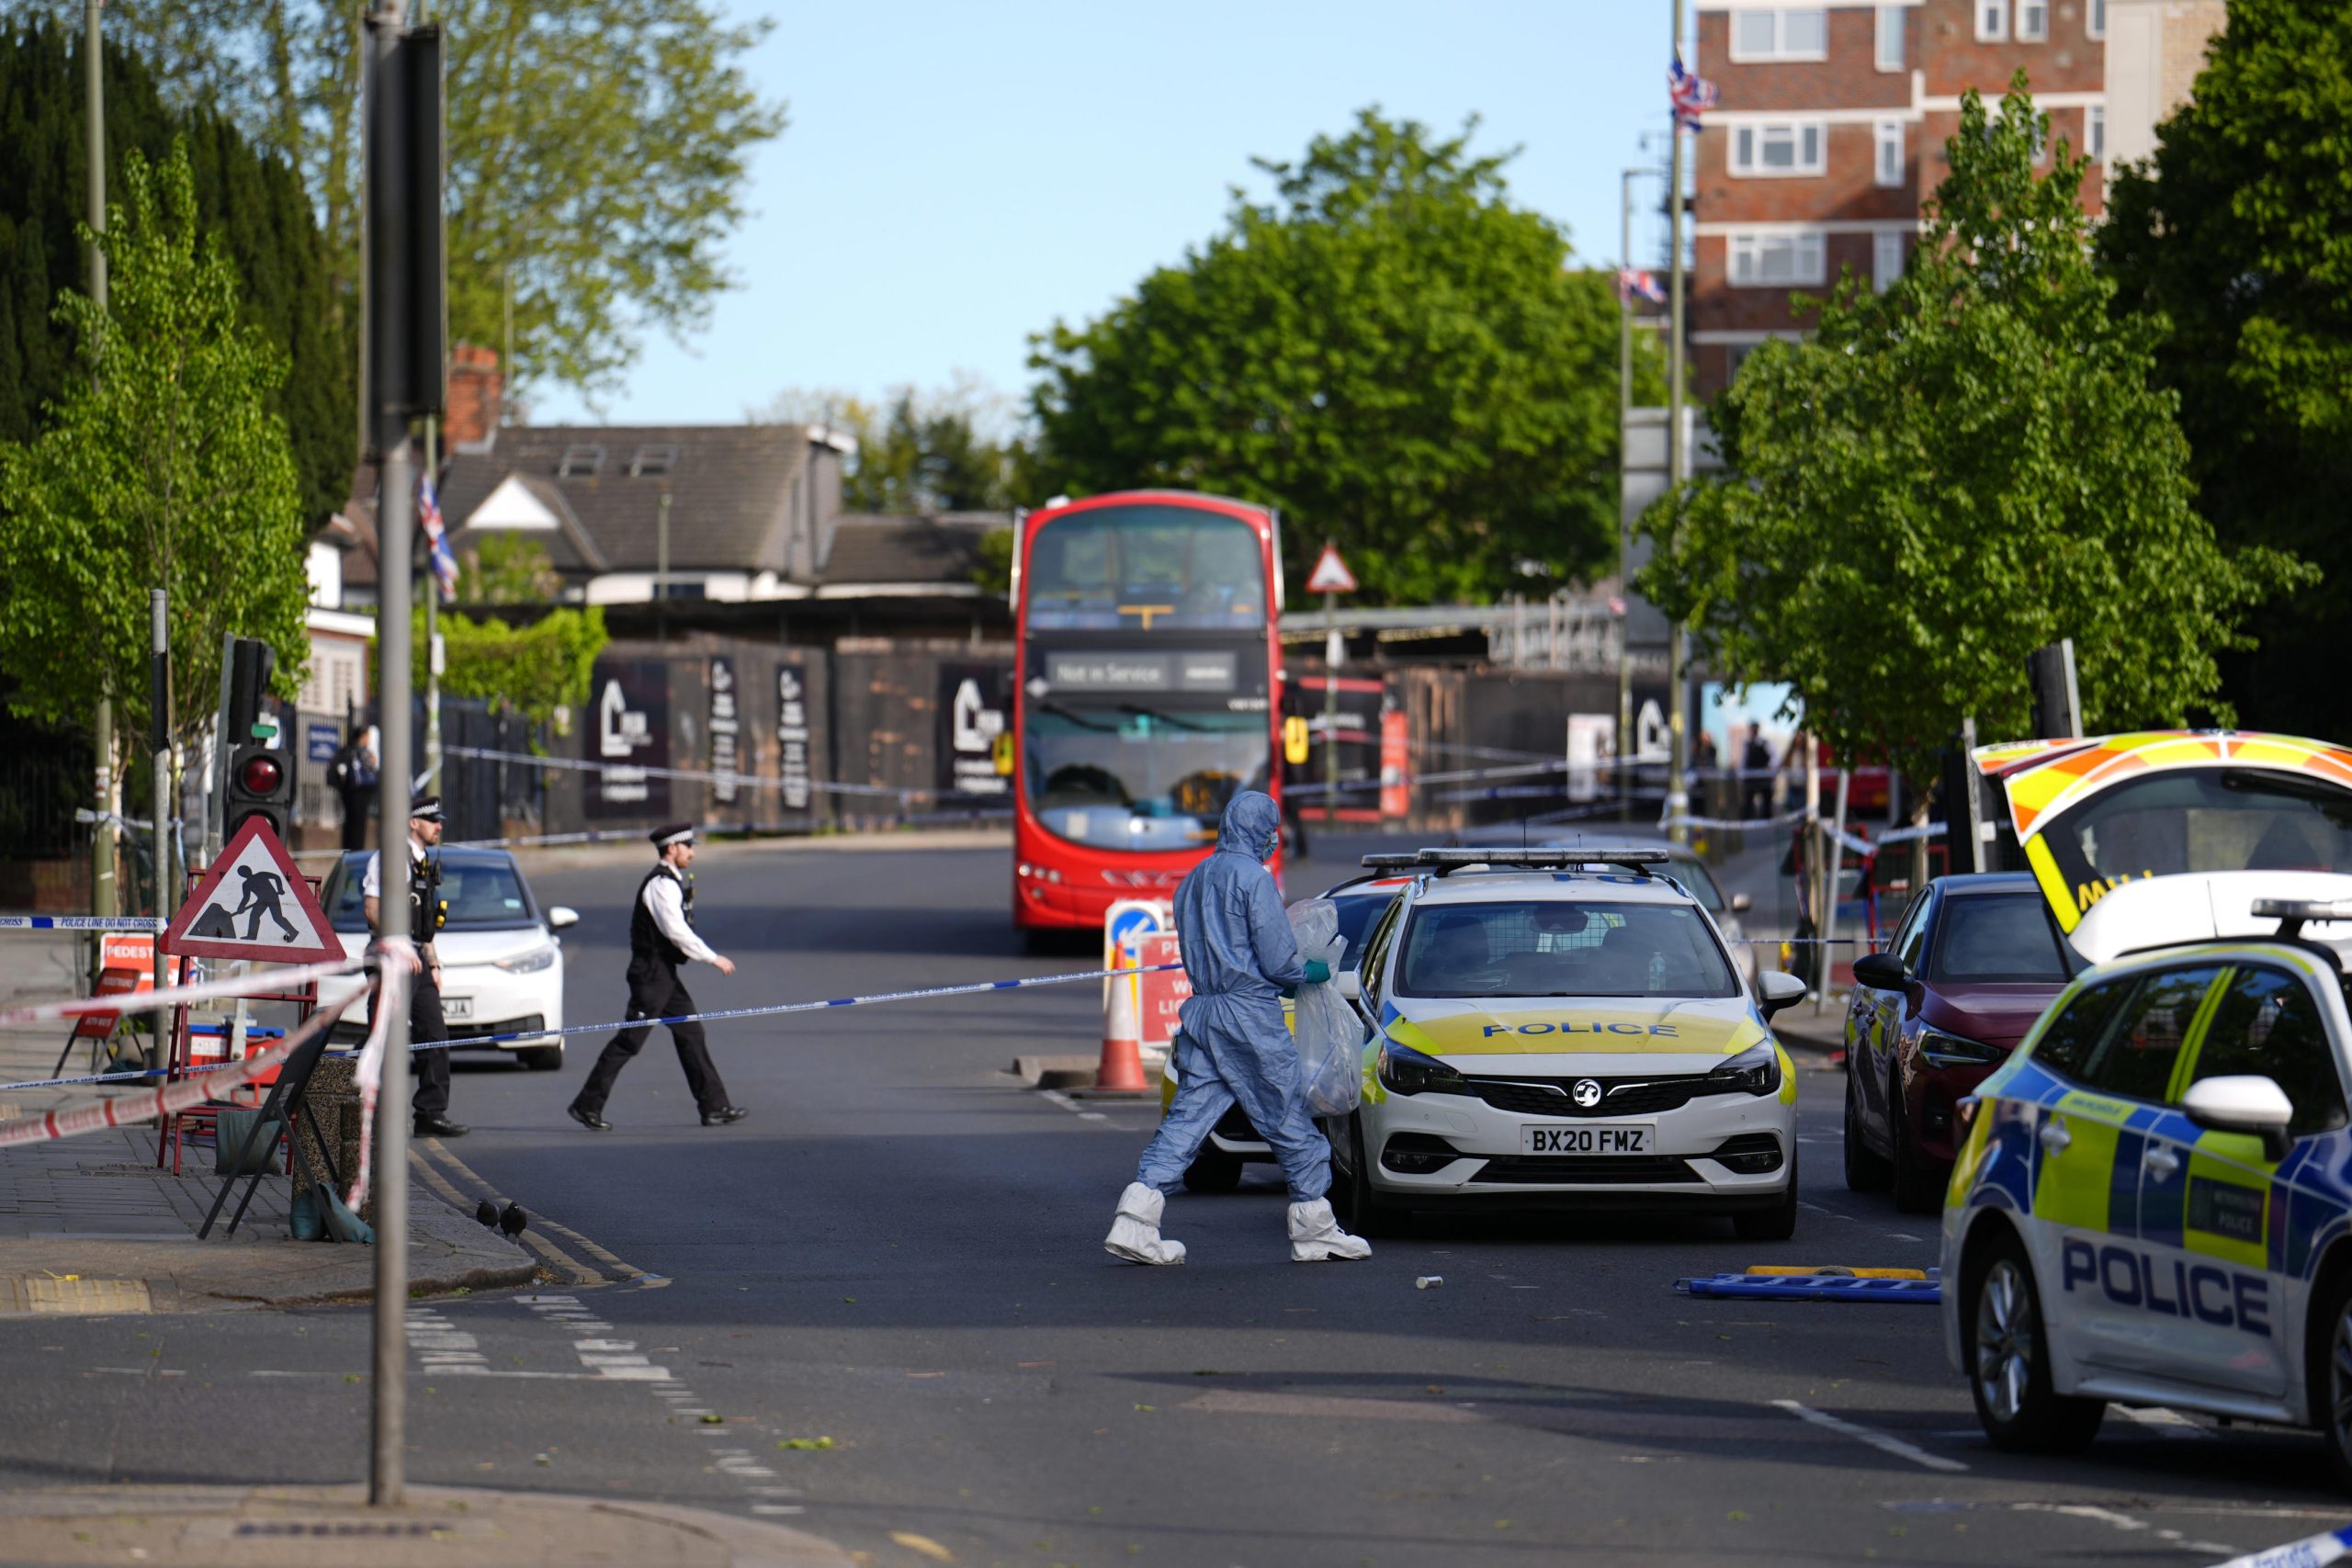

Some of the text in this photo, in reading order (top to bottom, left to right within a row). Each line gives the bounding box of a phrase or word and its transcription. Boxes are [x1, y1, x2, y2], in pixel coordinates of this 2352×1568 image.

[1105, 662, 1161, 682] Service
[61, 917, 157, 928] POLICE LINE DO NOT CROSS
[106, 945, 154, 958] PEDEST
[1483, 1021, 1679, 1038] POLICE
[1532, 1130, 1644, 1152] BX20 FMZ
[2063, 1236, 2272, 1337] POLICE
